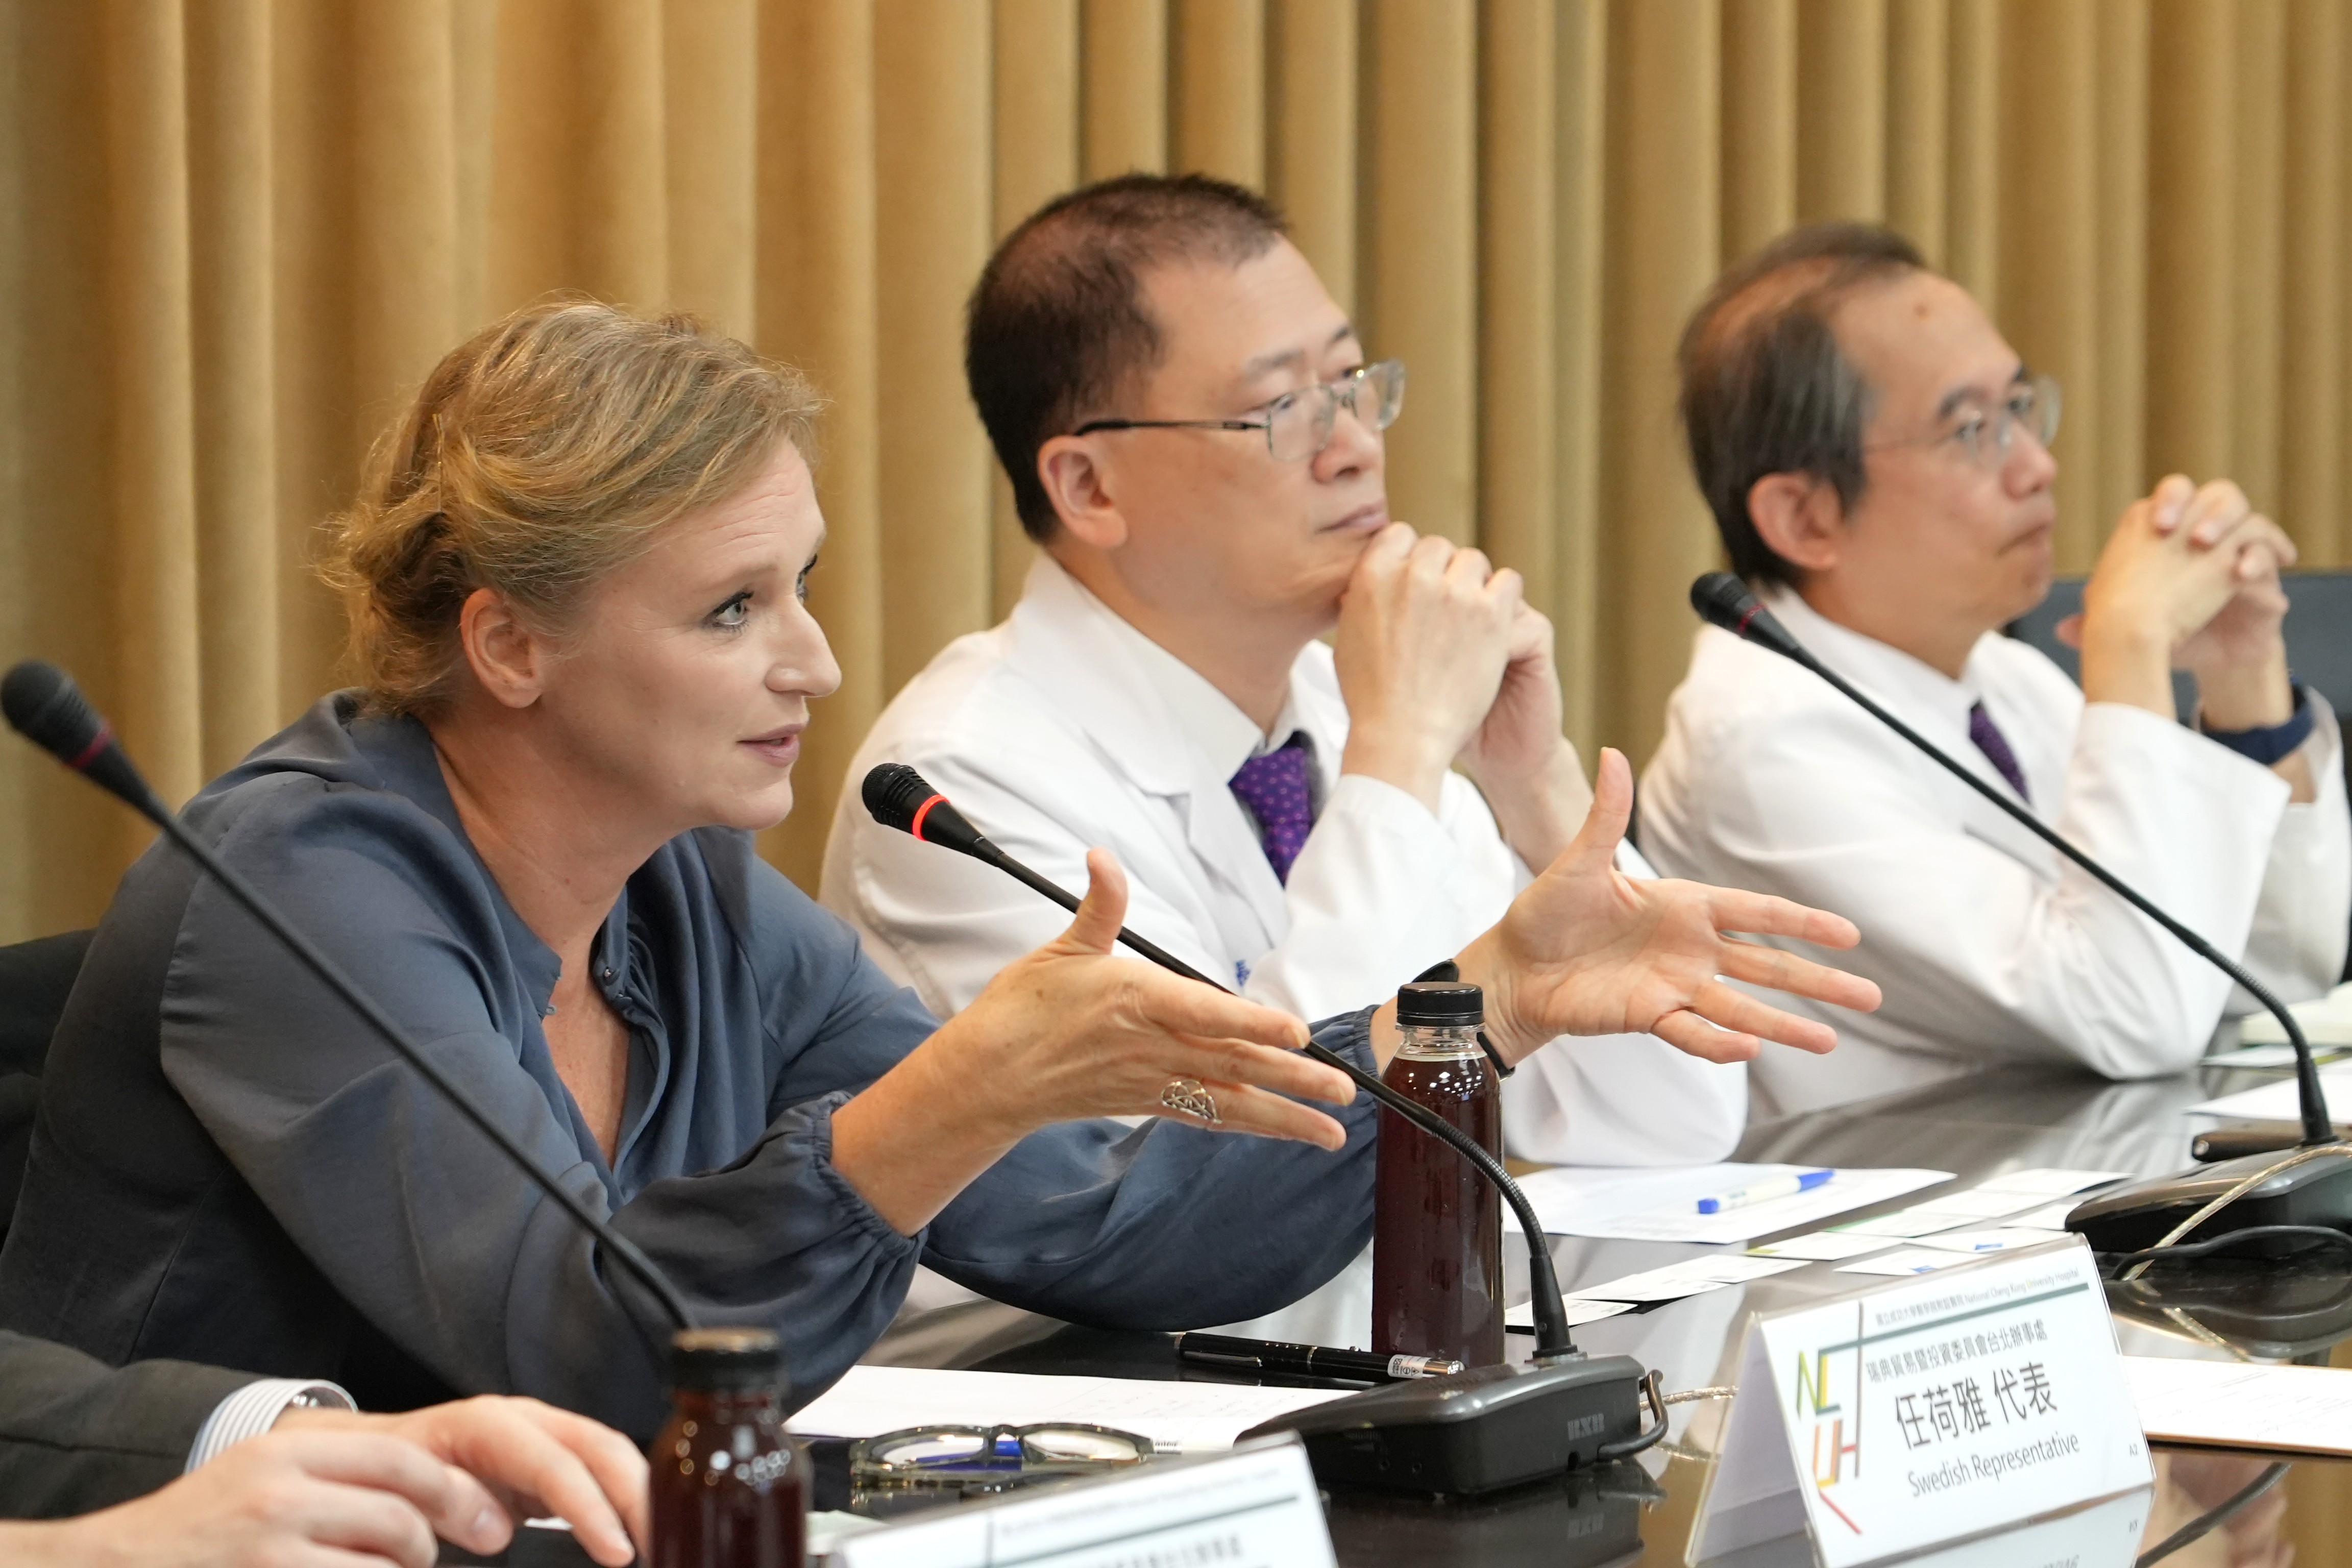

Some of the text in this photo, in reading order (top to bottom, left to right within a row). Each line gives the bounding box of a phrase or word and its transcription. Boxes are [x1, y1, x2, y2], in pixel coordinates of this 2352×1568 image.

[2010, 1283, 2026, 1293] Kung
[2026, 1275, 2054, 1289] University
[2055, 1267, 2079, 1282] Hospital
[1895, 1361, 2057, 1450] 任荷雅 代表
[1908, 1431, 2080, 1498] Swedish Representative
